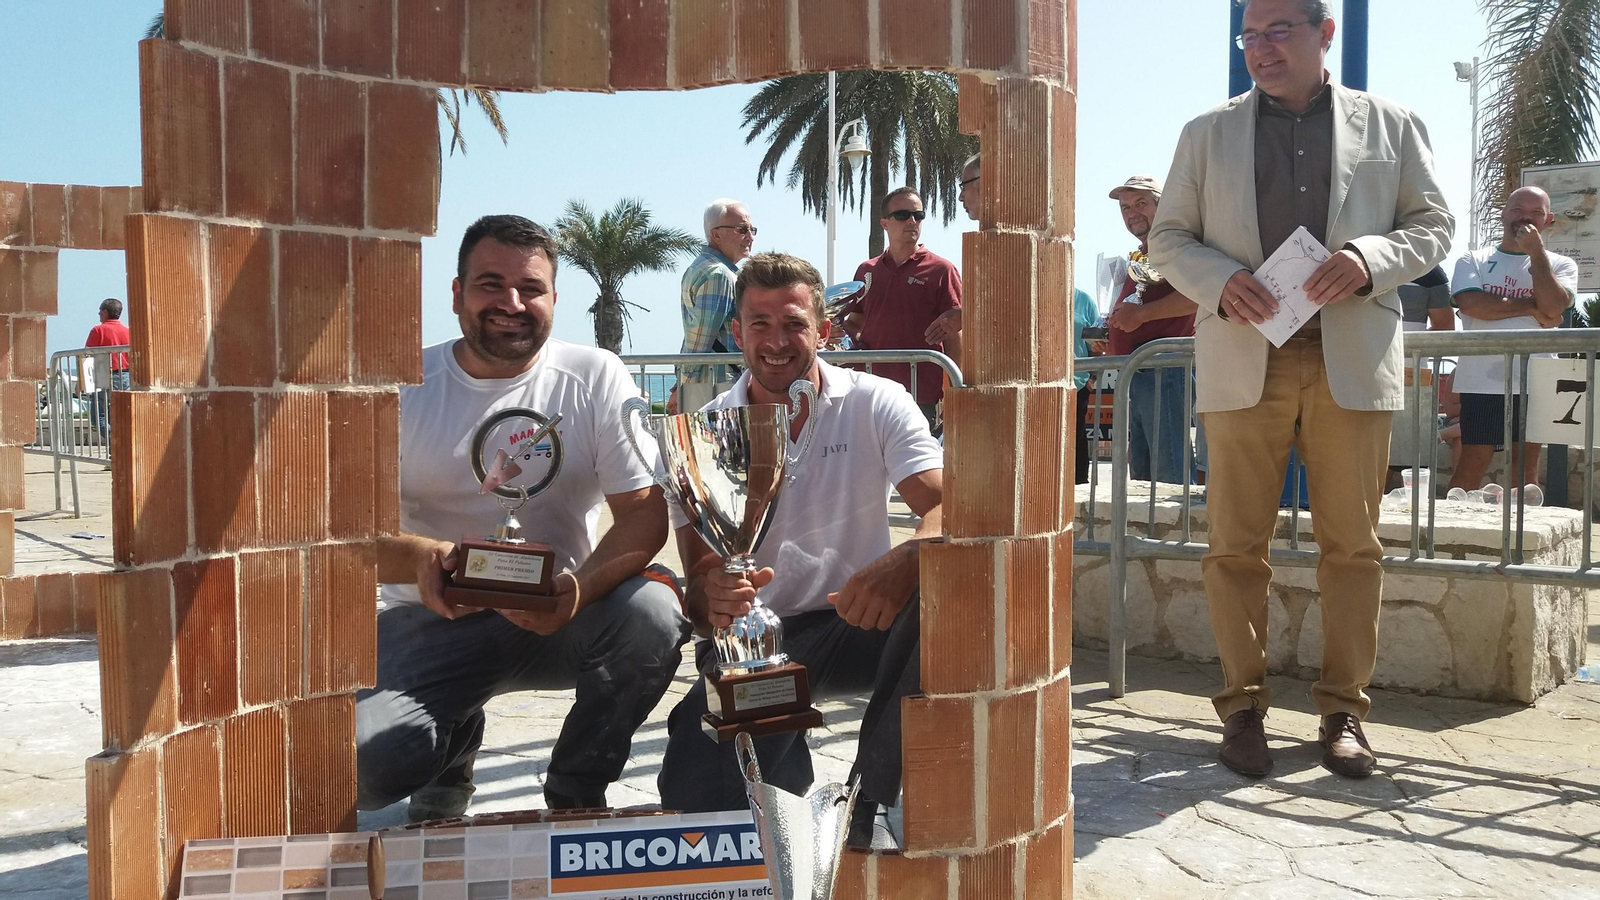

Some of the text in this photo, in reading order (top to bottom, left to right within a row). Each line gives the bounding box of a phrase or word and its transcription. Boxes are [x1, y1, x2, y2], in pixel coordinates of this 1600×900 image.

[1487, 260, 1498, 273] 7
[1504, 275, 1518, 287] Fly
[1482, 283, 1535, 299] Emiates
[1552, 379, 1587, 425] 7
[821, 443, 848, 458] JAVI
[652, 889, 726, 900] construcción
[728, 890, 735, 900] y
[738, 887, 748, 898] la
